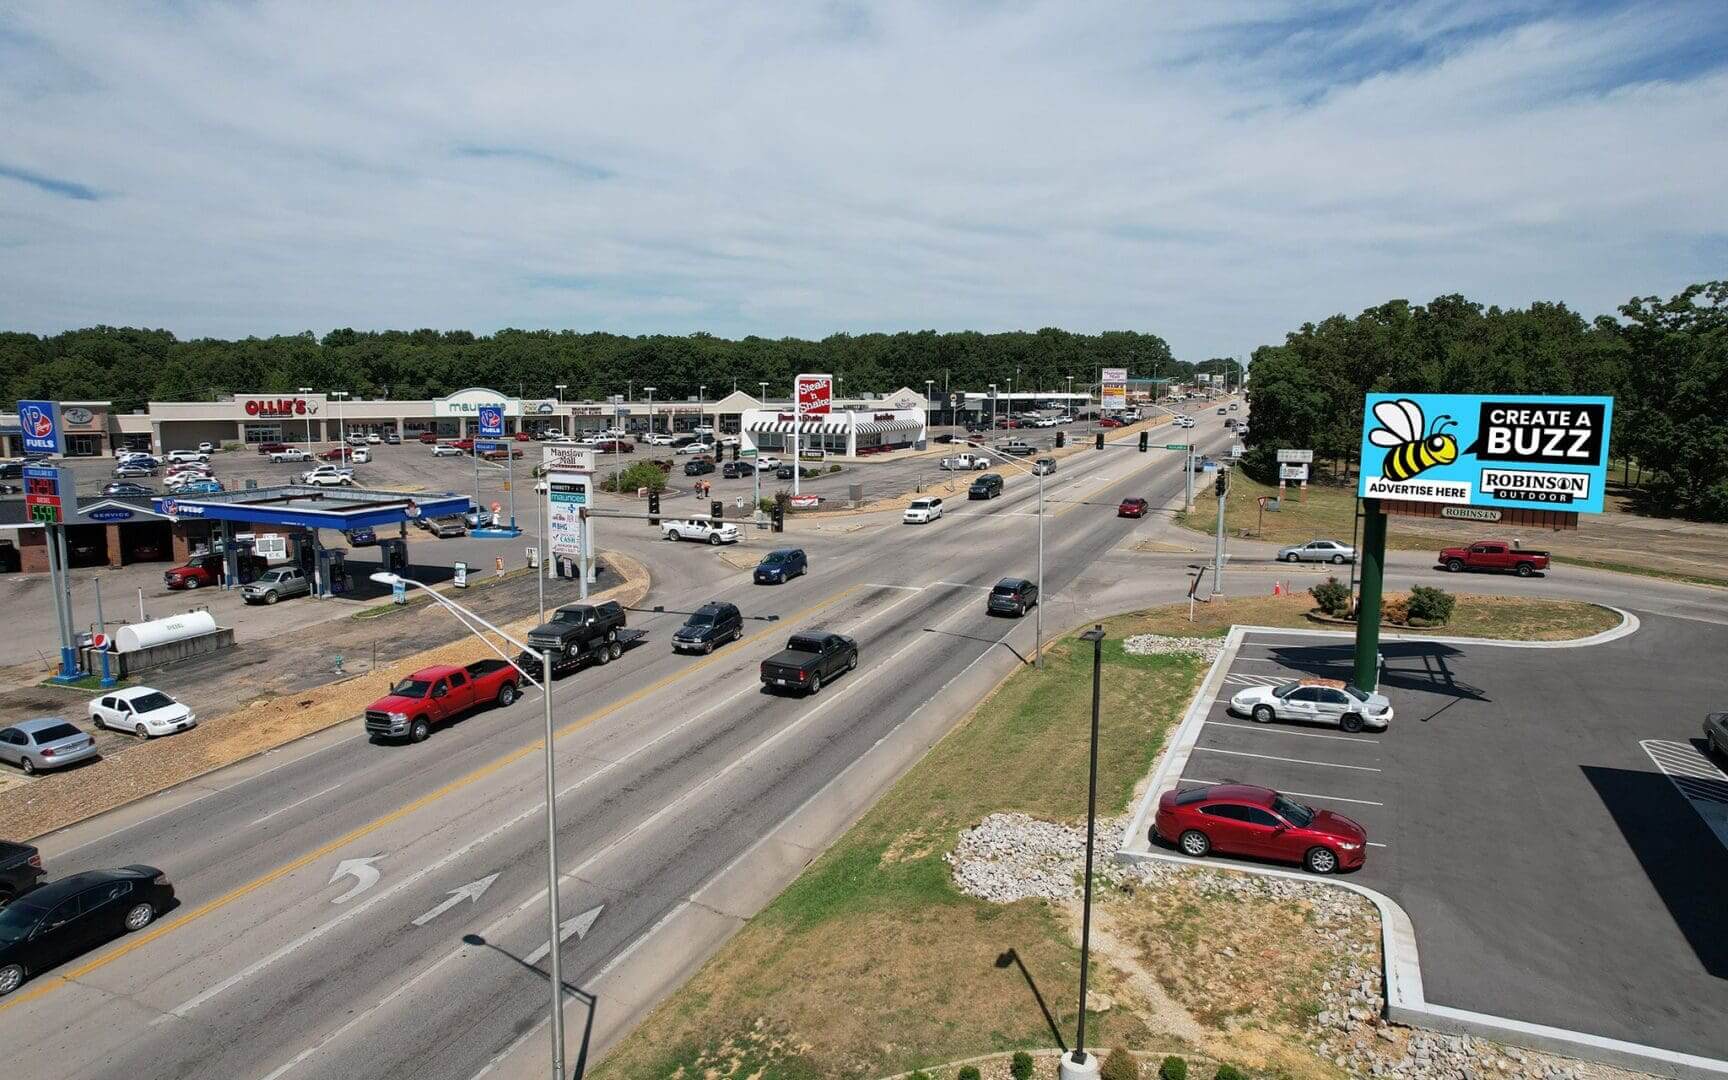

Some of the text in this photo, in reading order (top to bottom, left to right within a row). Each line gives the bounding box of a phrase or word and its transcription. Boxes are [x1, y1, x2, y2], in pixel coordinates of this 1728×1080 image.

[800, 379, 827, 394] Steak
[245, 398, 306, 415] OLLIE'S
[800, 398, 829, 412] Shake
[1490, 409, 1591, 427] CREATE A
[26, 439, 54, 448] FUELS
[1487, 427, 1592, 458] BUZZ
[551, 448, 583, 457] Mansion
[1486, 474, 1584, 491] ROBINSON
[1369, 483, 1466, 498] ADVERTISE HERE
[1500, 491, 1567, 501] OUTDOOR
[1446, 508, 1497, 519] ROBINSON
